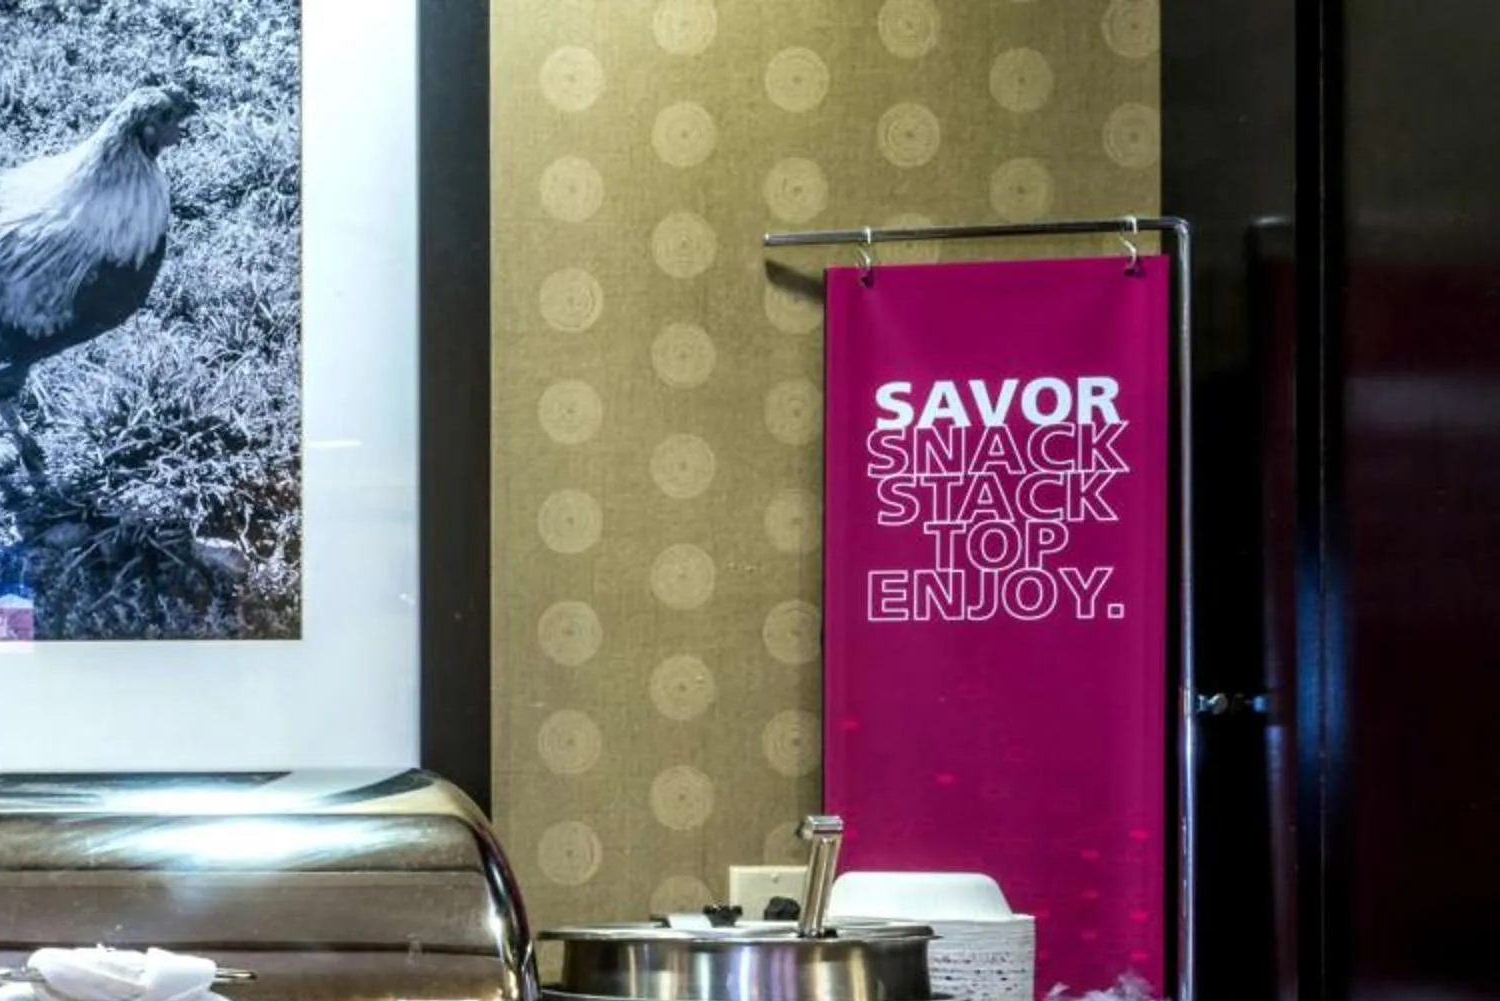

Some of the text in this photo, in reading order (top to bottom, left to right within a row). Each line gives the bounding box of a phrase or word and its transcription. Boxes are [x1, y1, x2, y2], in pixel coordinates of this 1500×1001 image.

[874, 376, 1120, 430] SAVOR
[866, 421, 1130, 478] SNACK
[877, 470, 1118, 526] STACK
[923, 519, 1069, 572] TOP
[867, 566, 1125, 622] ENJOY.
